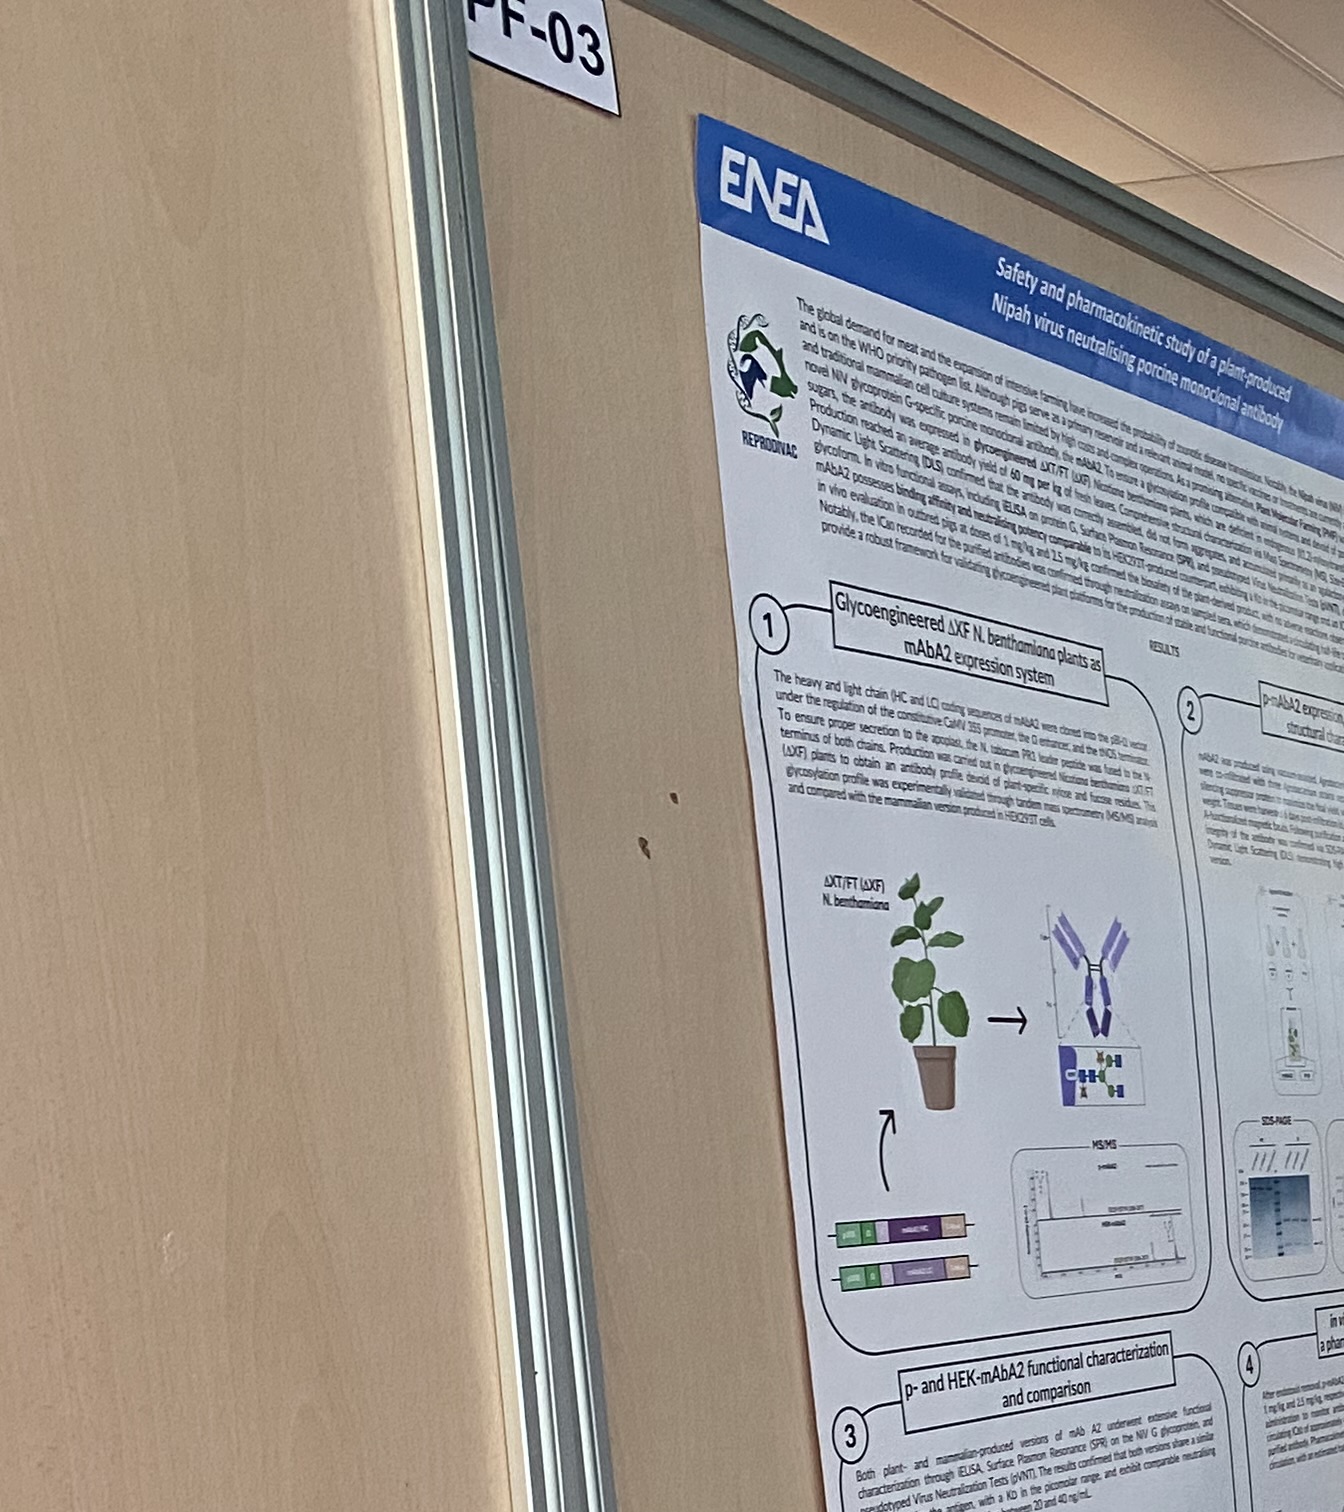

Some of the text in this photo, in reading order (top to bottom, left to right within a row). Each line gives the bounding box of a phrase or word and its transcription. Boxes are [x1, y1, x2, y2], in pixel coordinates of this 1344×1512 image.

[720, 147, 828, 243] ENEA
[996, 257, 1292, 402] Safety and pharmacokinetic study of a plant-produced
[991, 292, 1284, 435] Nipah virus neutralising porcine monoclonal antibody
[742, 430, 798, 459] REPRODIVAC
[762, 612, 773, 638] 1
[835, 592, 1102, 673] Glycoengineered ΔXF N. benthamiana plants as
[1149, 639, 1180, 658] RESULTS
[904, 638, 1055, 687] mAbA2 expression system
[1186, 700, 1196, 720] 2
[1262, 693, 1302, 714] p-mAbA2
[1286, 721, 1326, 741] structural
[822, 892, 890, 911] N. benthamiana
[1092, 1138, 1117, 1151] MS/MS
[1329, 1313, 1338, 1328] in
[1320, 1340, 1326, 1353] a
[904, 1341, 1169, 1402] p- and HEK-mAbA2 functional characterization
[1245, 1354, 1254, 1374] 4
[1002, 1380, 1091, 1408] and comparison
[844, 1423, 857, 1449] 3
